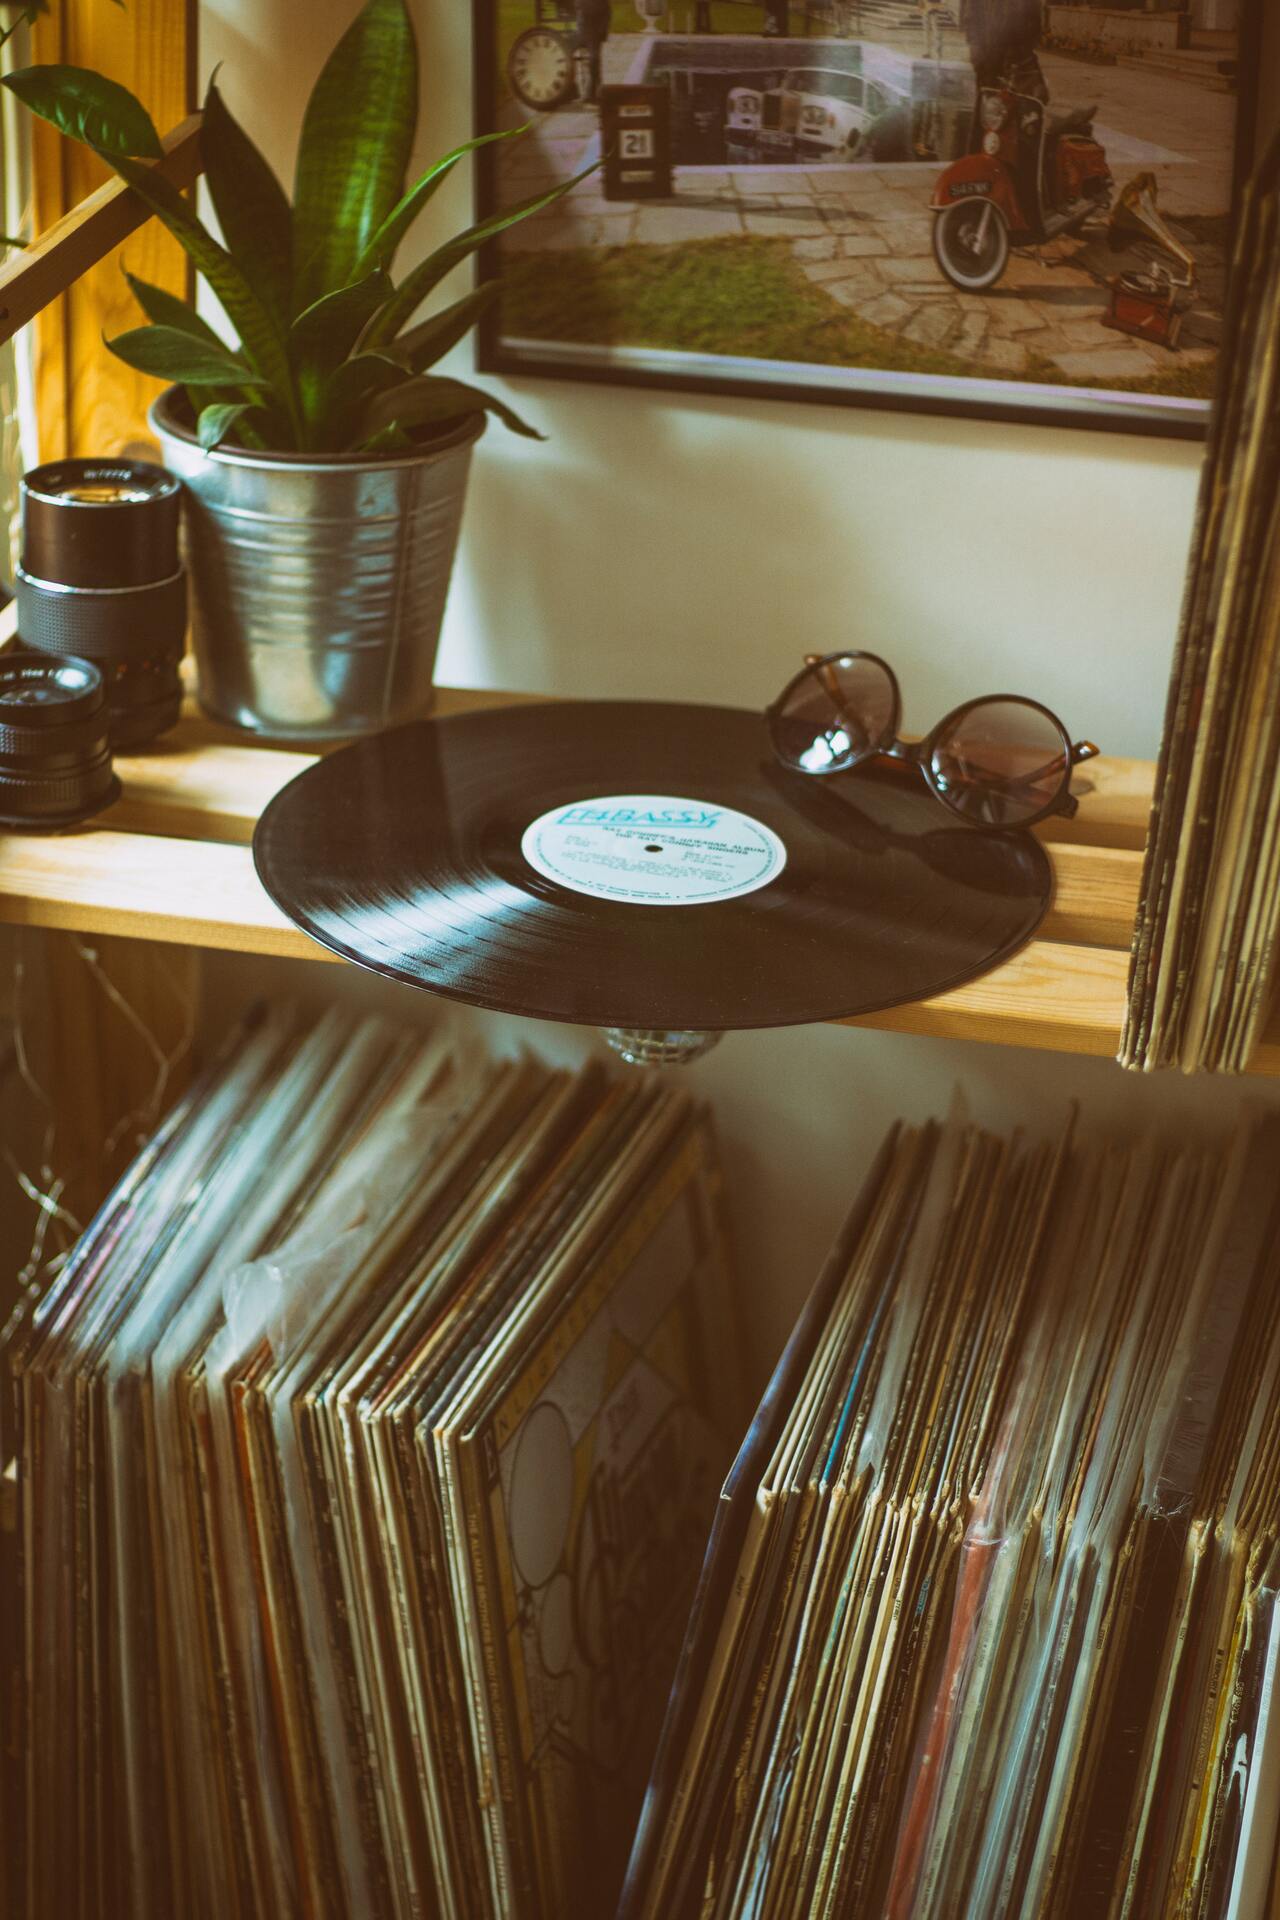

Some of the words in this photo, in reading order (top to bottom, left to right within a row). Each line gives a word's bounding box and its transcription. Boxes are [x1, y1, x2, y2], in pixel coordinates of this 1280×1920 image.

[624, 133, 648, 154] 21
[467, 1513, 477, 1534] THE
[470, 1537, 483, 1582] ALLMAN
[476, 1584, 491, 1643] BROTHERS
[1209, 1658, 1222, 1691] MERCURY
